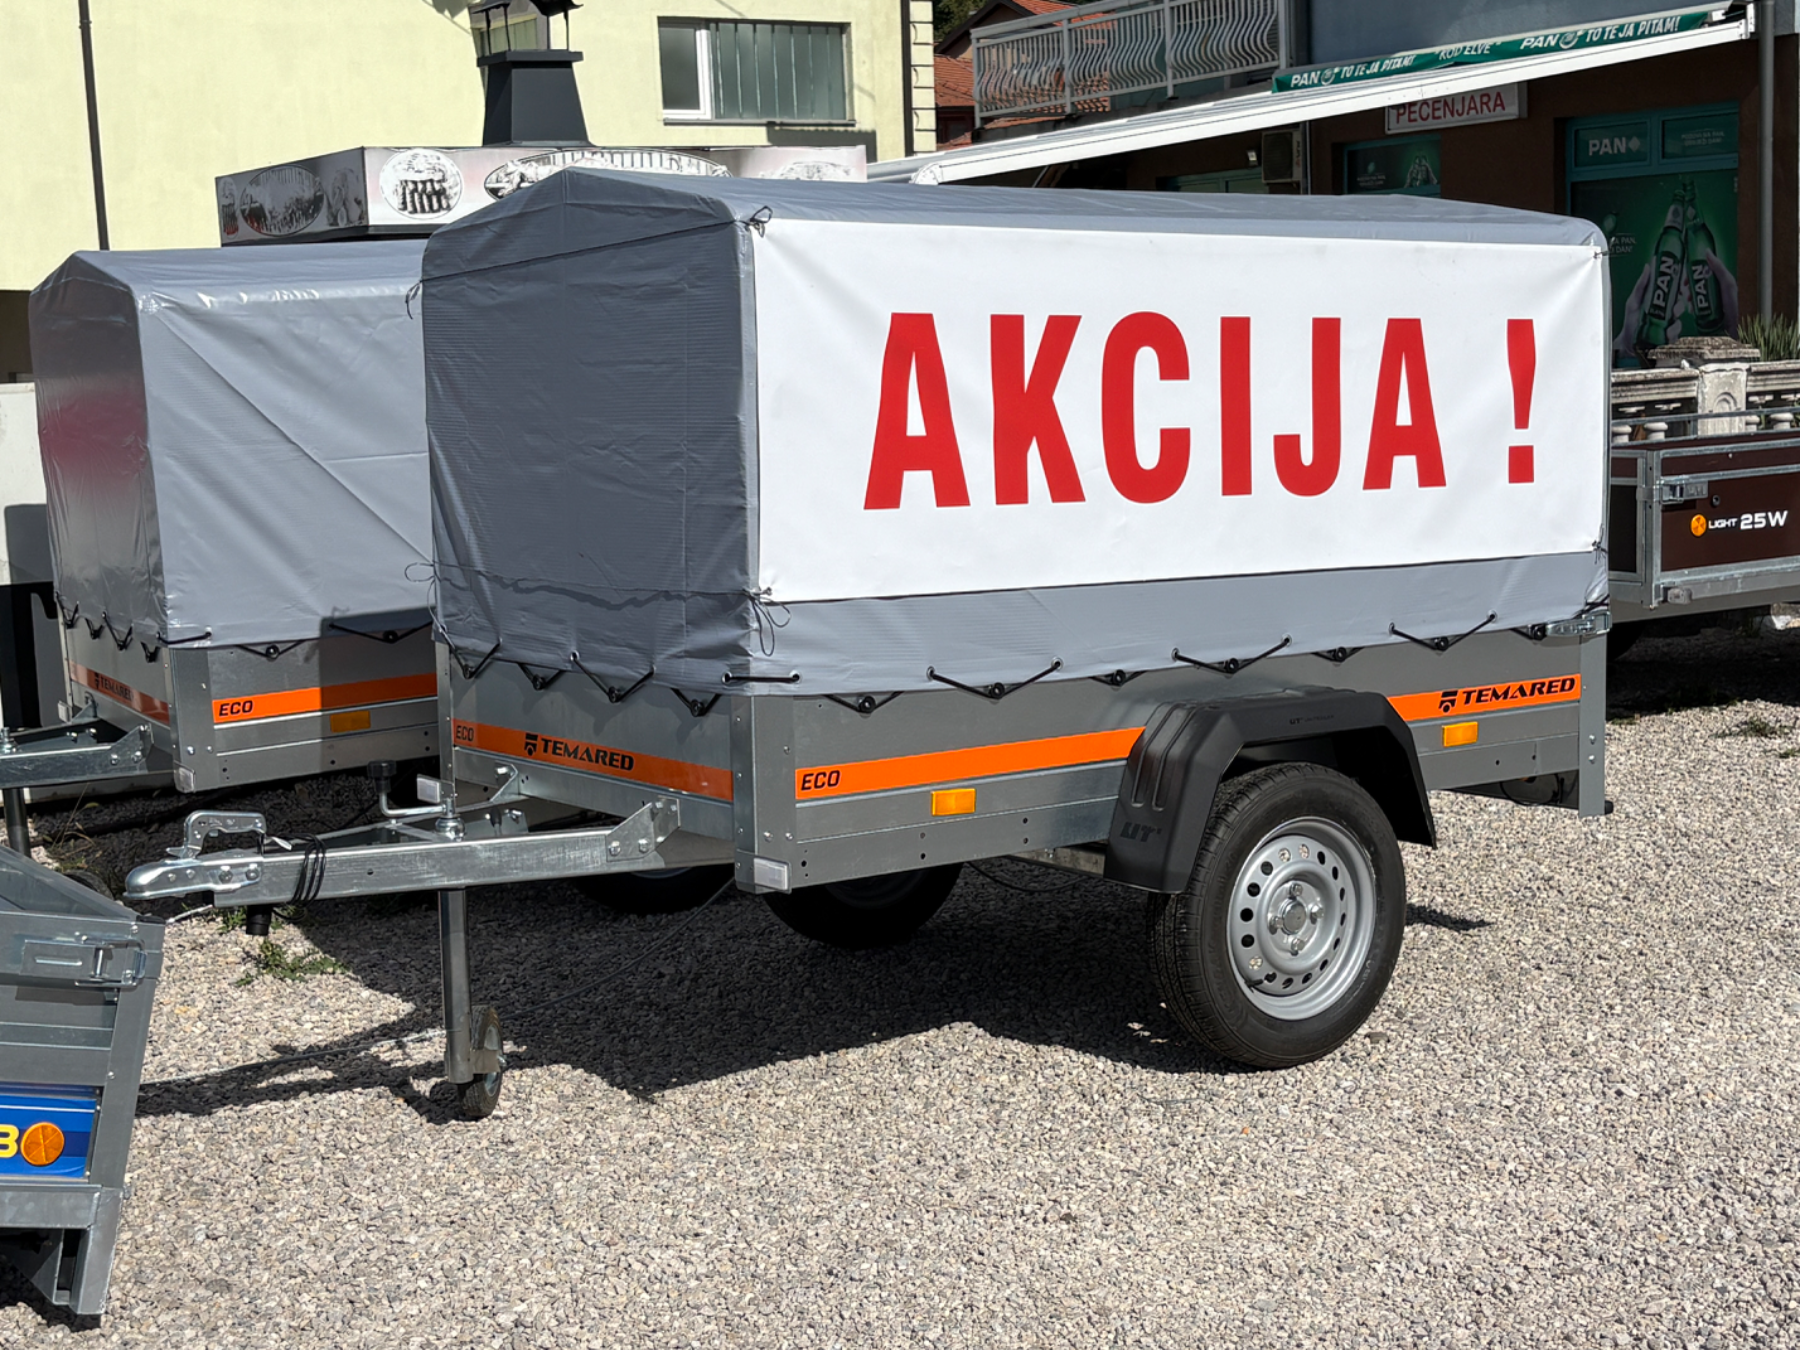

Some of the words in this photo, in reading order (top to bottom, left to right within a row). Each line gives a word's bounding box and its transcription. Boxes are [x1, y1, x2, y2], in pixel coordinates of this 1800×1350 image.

[1519, 34, 1560, 50] PAN
[1585, 29, 1601, 43] TO
[1604, 26, 1617, 41] TE
[1618, 24, 1634, 37] JA
[1637, 16, 1682, 36] PITAM!
[1290, 69, 1321, 88] PAN
[1341, 65, 1354, 79] TO
[1354, 63, 1368, 77] TE
[1588, 136, 1627, 156] PAN
[1652, 255, 1675, 308] PAN
[1691, 264, 1709, 308] PAN
[864, 311, 1446, 510] AKCIJA
[1708, 517, 1738, 530] LIGHT
[1740, 510, 1789, 530] 25W
[1462, 677, 1576, 706] TEMARED
[218, 700, 254, 717] ECO
[456, 725, 475, 742] ECO
[541, 737, 635, 772] TEMARED
[801, 770, 841, 791] ECO
